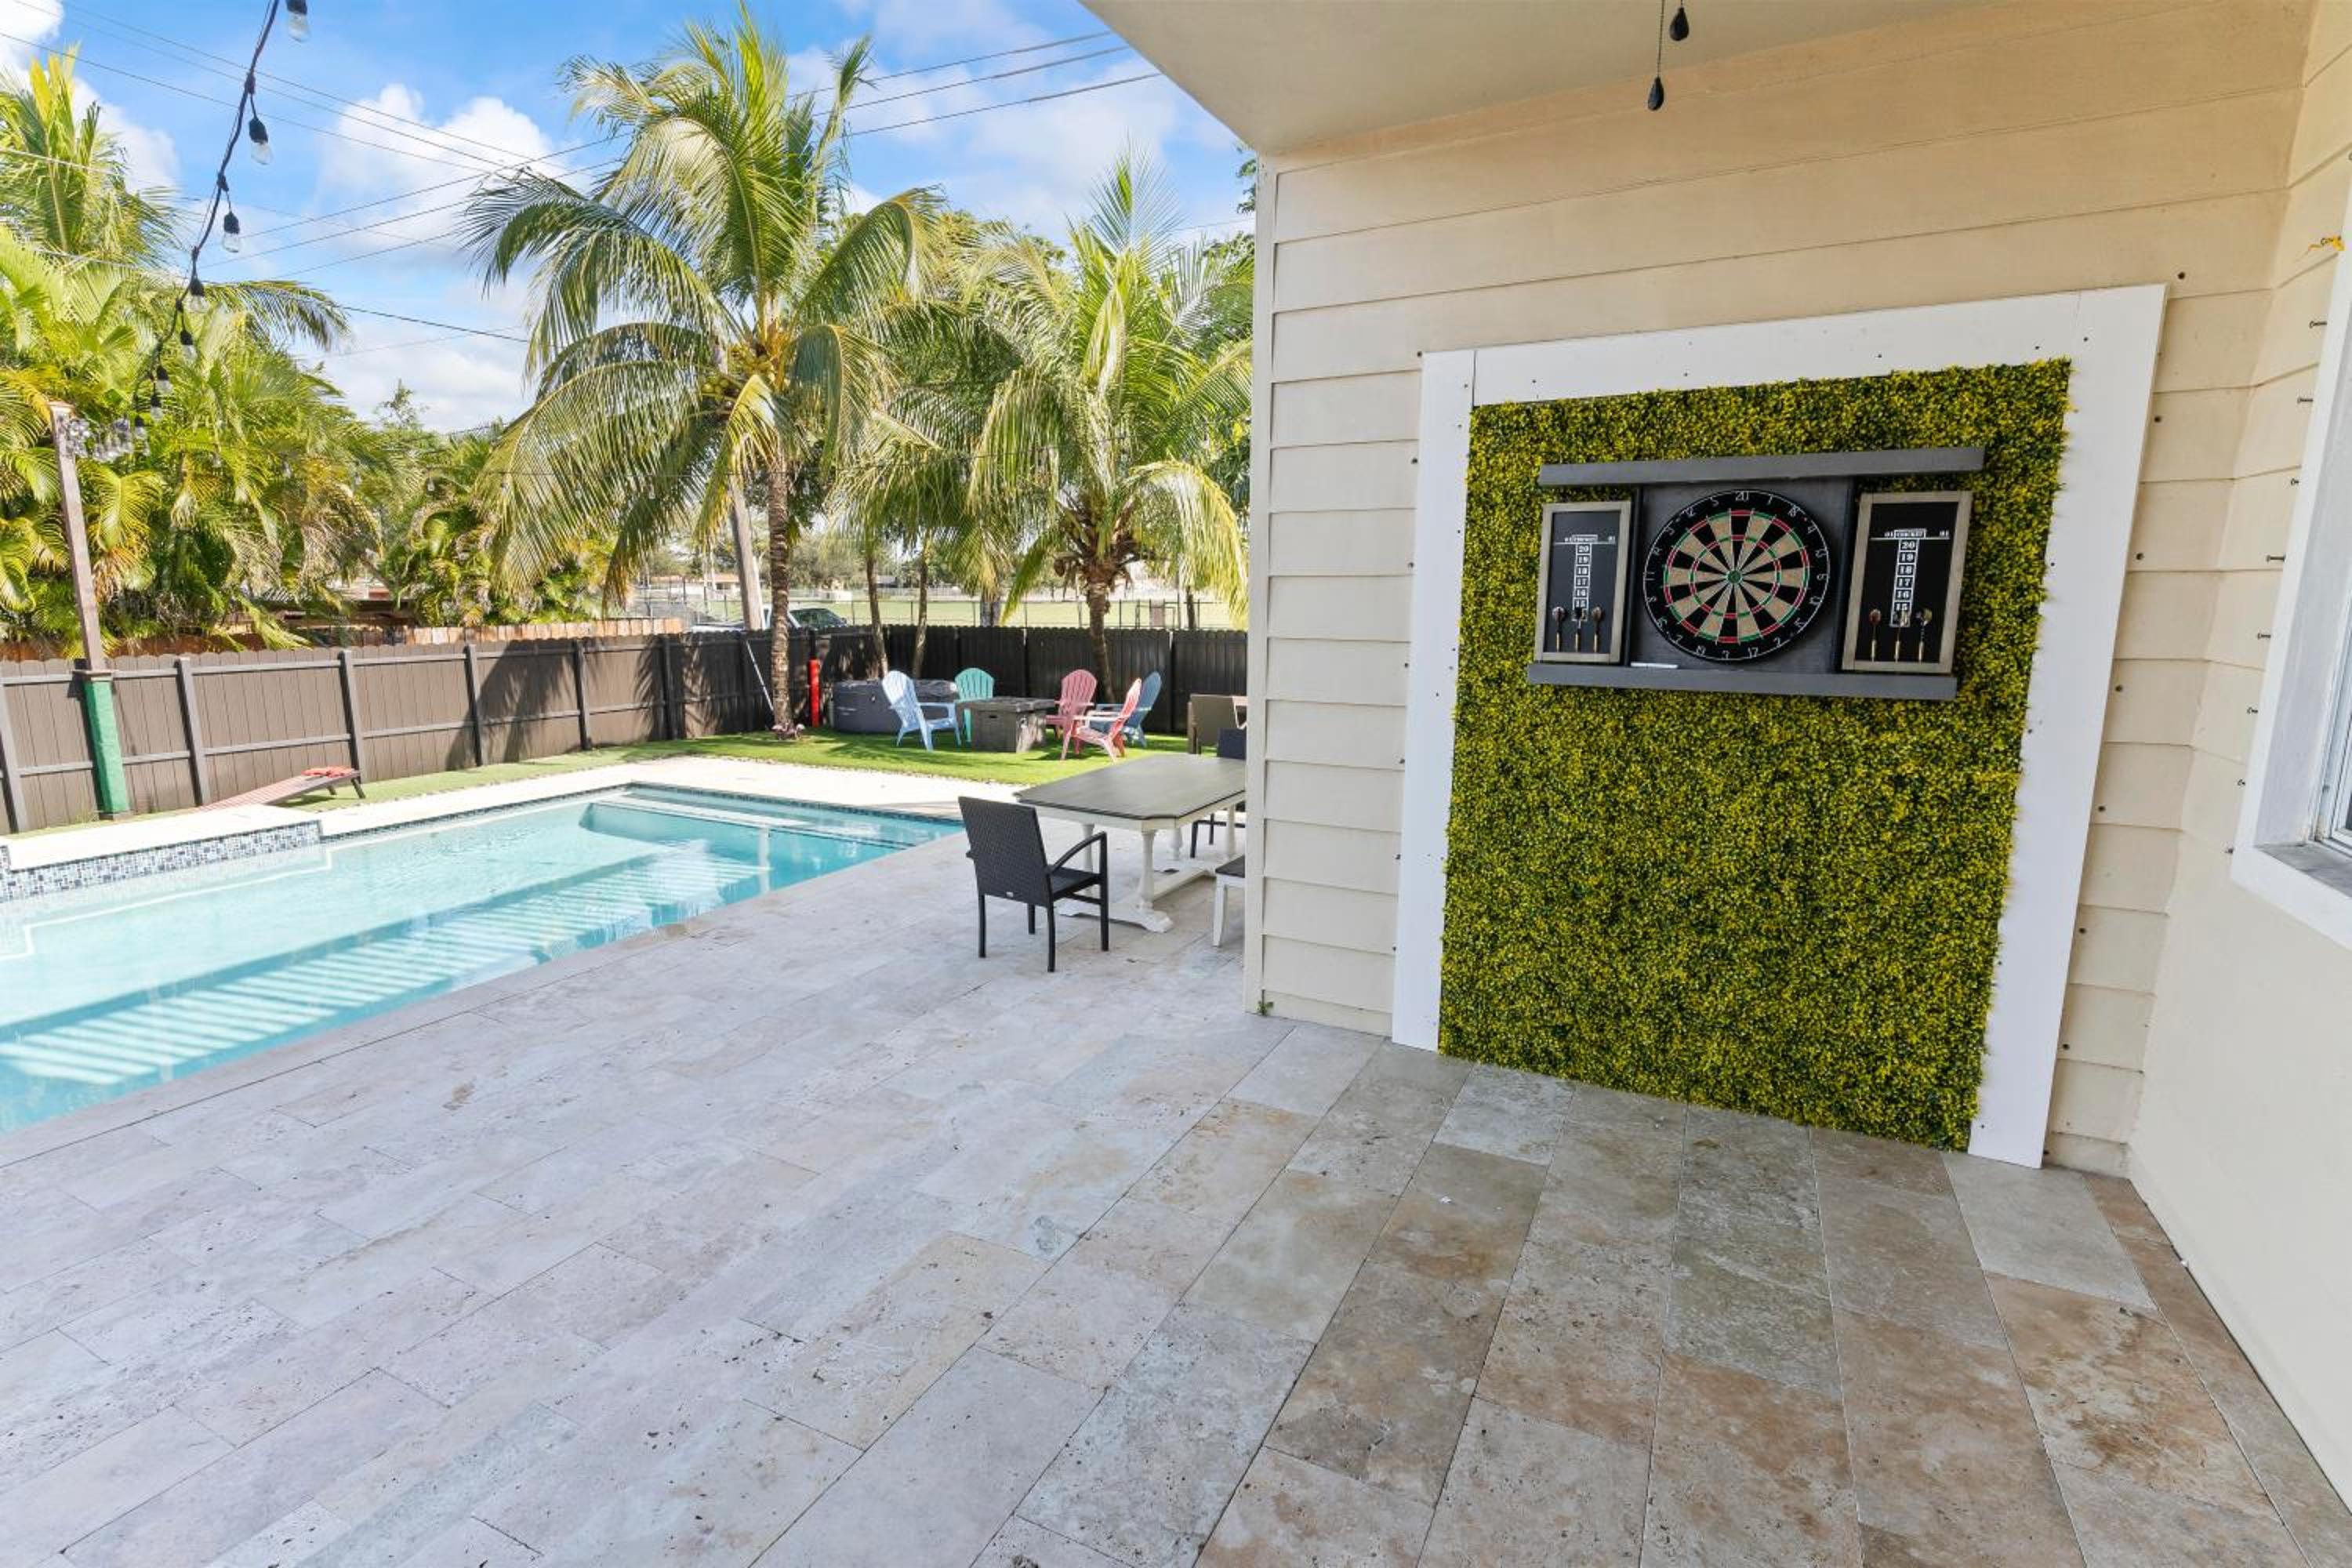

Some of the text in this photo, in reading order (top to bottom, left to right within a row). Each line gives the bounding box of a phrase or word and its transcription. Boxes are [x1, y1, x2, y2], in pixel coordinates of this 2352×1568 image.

[1735, 491, 1749, 501] 20
[1901, 540, 1915, 550] 20
[1901, 553, 1914, 561] 19
[1900, 565, 1912, 575] 18
[1898, 578, 1911, 587] 17
[1896, 590, 1910, 599] 16
[1895, 603, 1907, 612] 15
